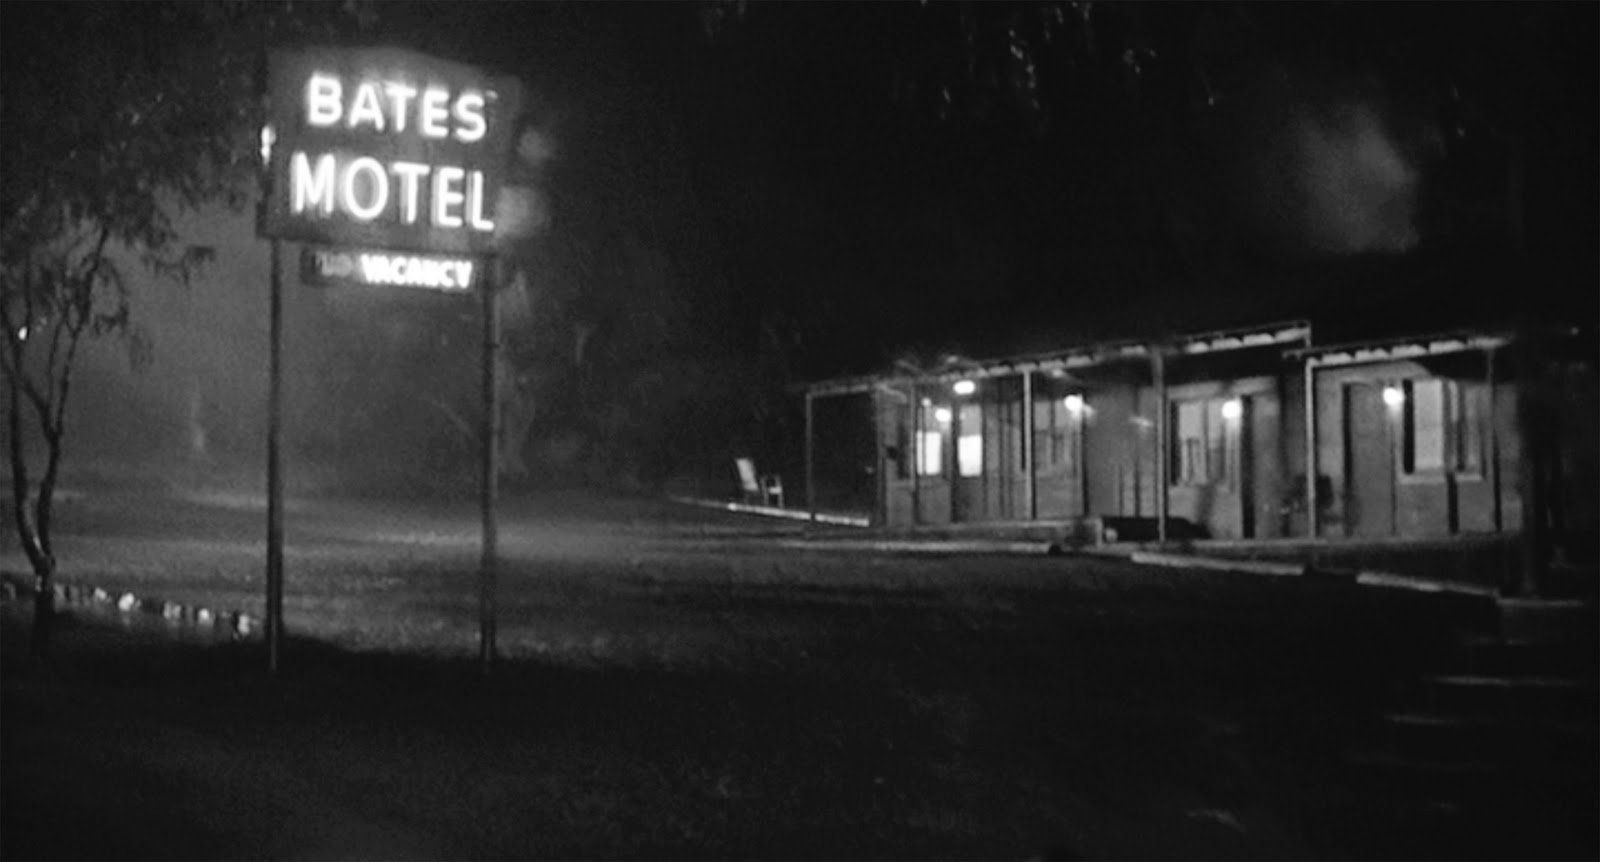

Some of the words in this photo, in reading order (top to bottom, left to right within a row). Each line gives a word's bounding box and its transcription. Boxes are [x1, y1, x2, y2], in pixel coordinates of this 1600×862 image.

[308, 72, 487, 141] BATES
[291, 151, 494, 230] MOTEL
[360, 253, 473, 288] VACANCY
